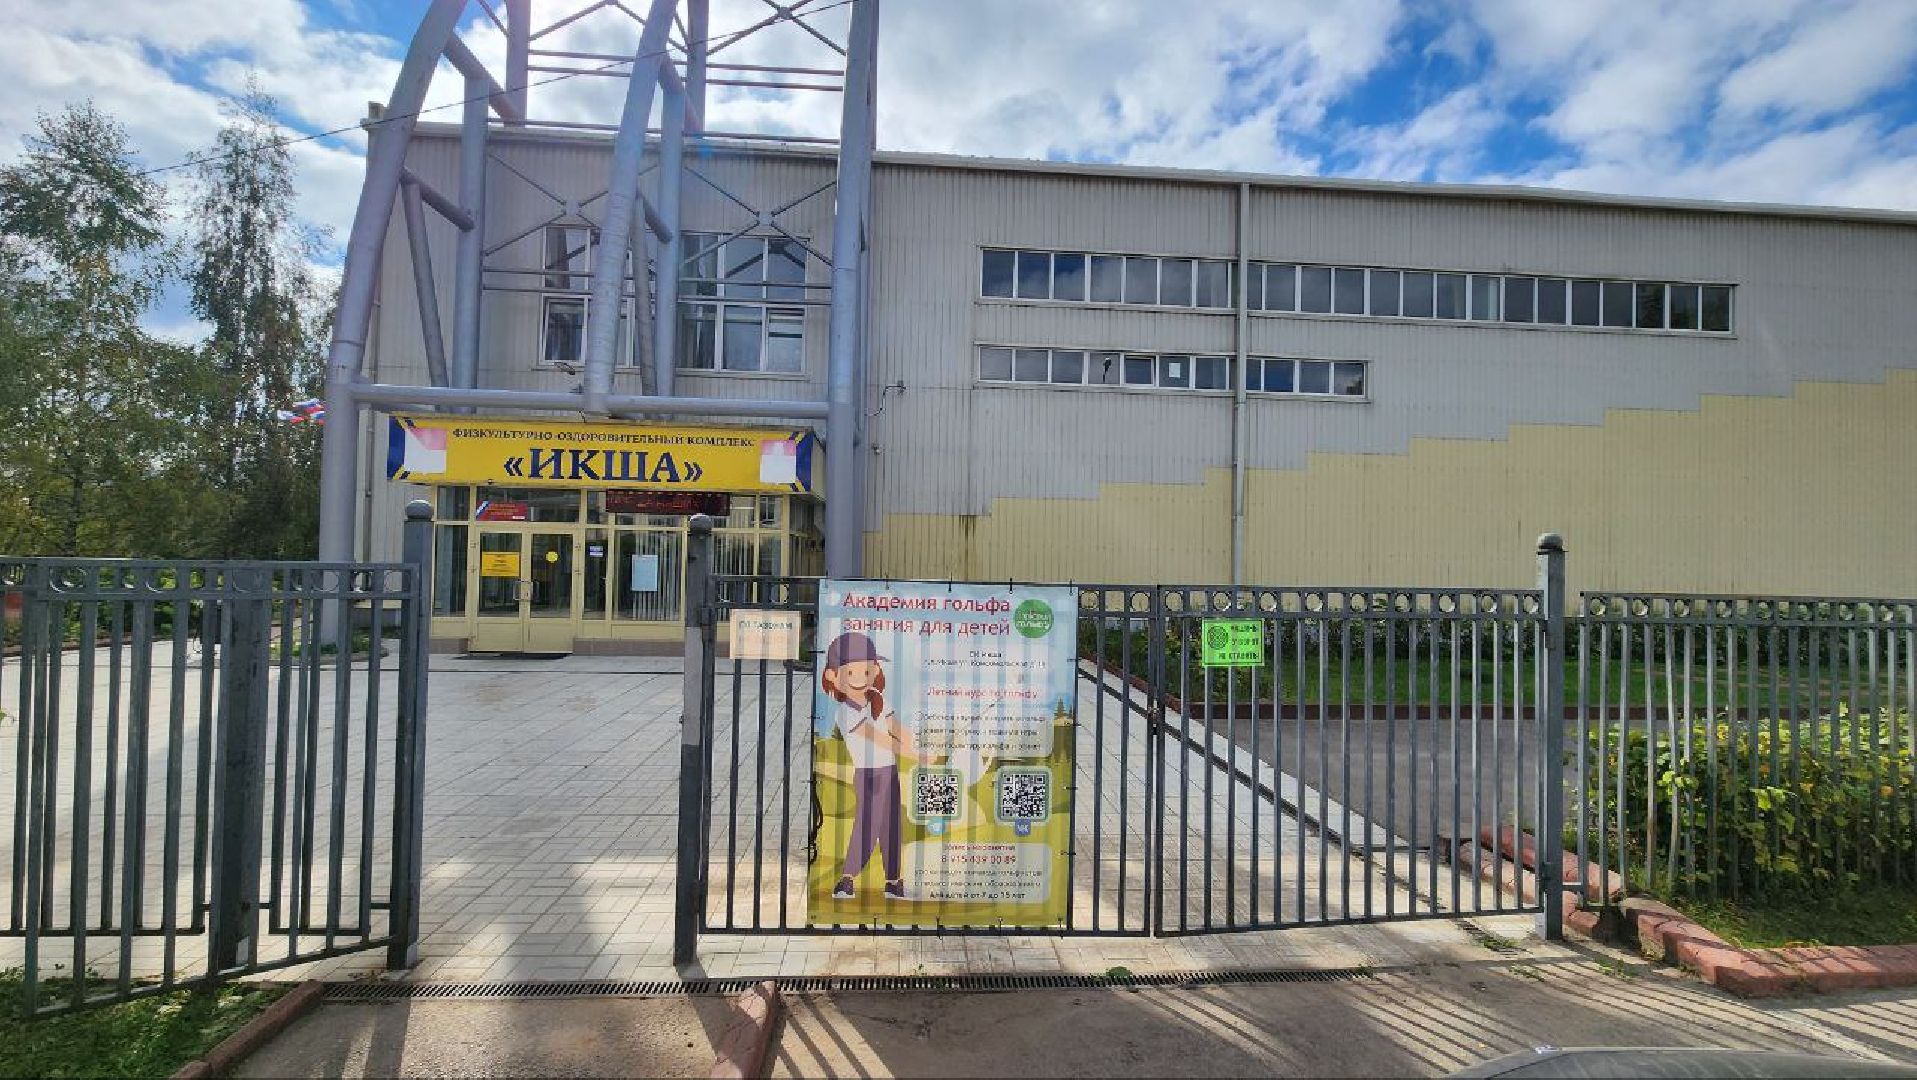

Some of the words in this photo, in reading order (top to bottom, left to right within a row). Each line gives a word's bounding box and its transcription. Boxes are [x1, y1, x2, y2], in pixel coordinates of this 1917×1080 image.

[687, 436, 755, 447] КОМПЛЕКС
[503, 448, 704, 483] «ИКША»
[843, 592, 938, 612] Академия
[944, 597, 1010, 615] гольфа
[843, 618, 914, 632] занятия
[919, 622, 953, 636] для
[958, 618, 1010, 637] детей
[941, 855, 947, 863] 8
[1001, 891, 1010, 899] 15
